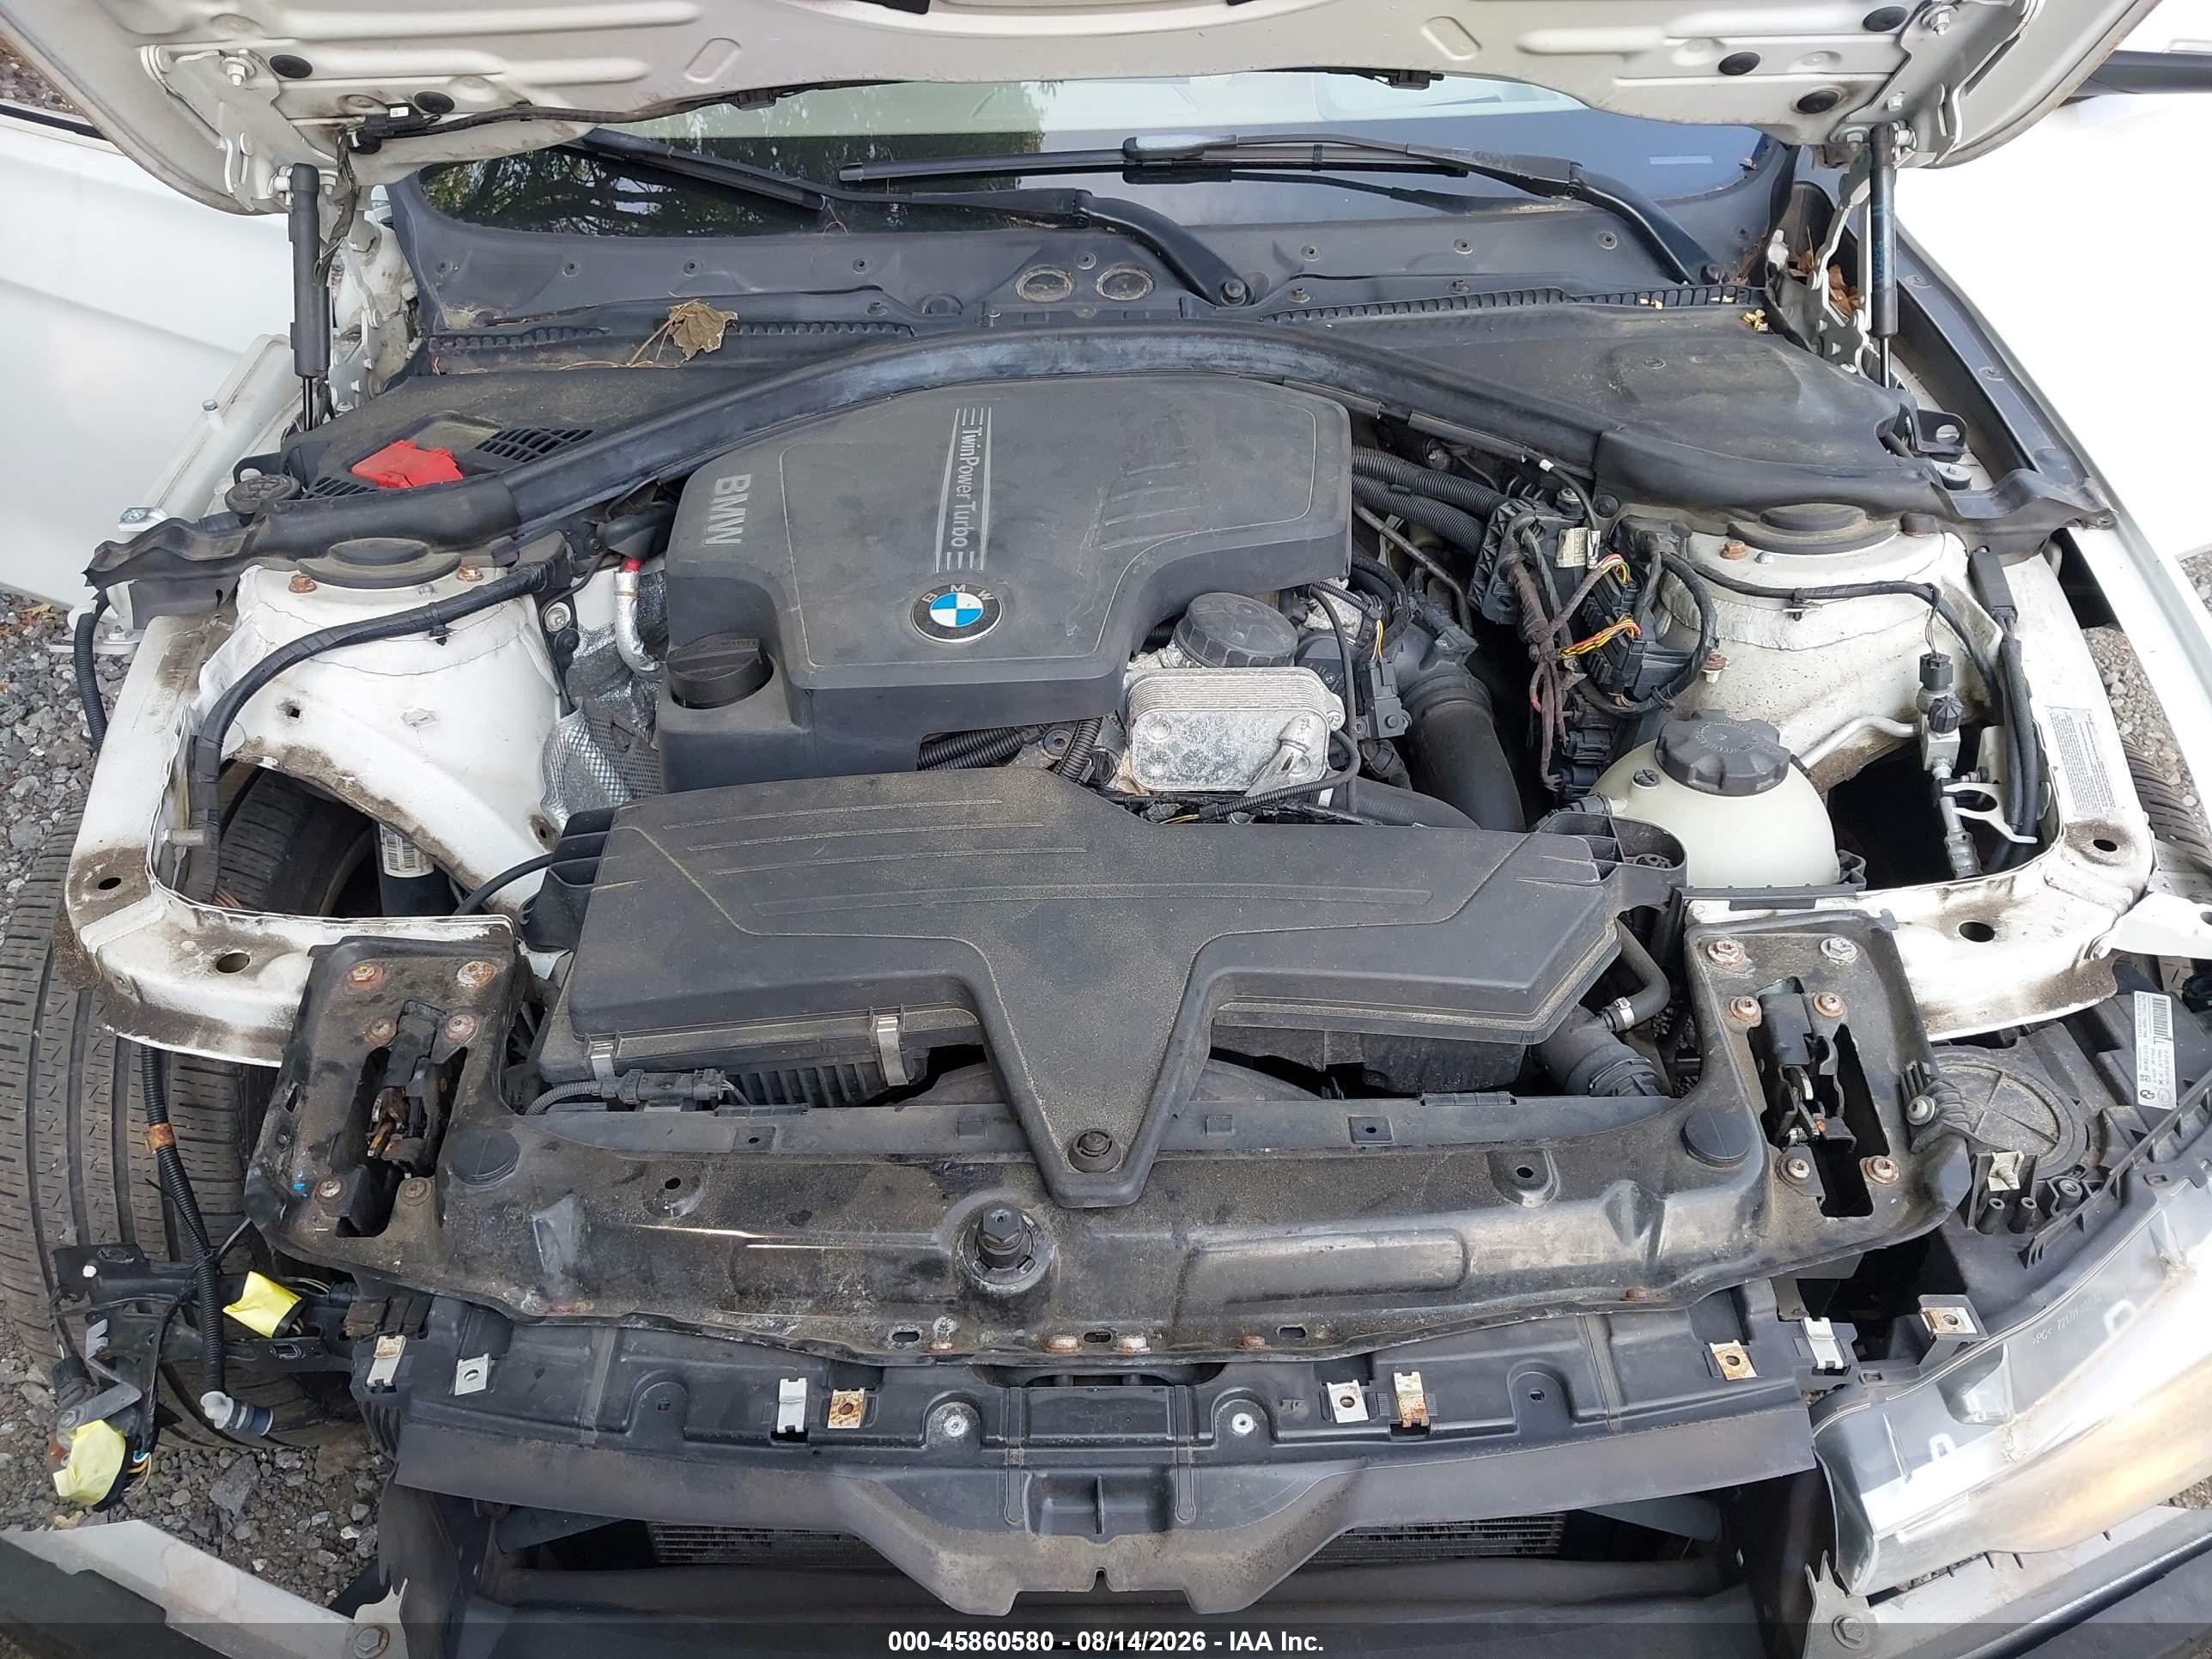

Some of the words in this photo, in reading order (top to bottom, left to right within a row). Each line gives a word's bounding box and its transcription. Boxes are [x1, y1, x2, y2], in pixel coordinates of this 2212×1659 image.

[956, 427, 982, 501] TwinPower
[705, 474, 751, 544] BMW
[951, 500, 976, 547] Turbo
[921, 584, 996, 604] BMW
